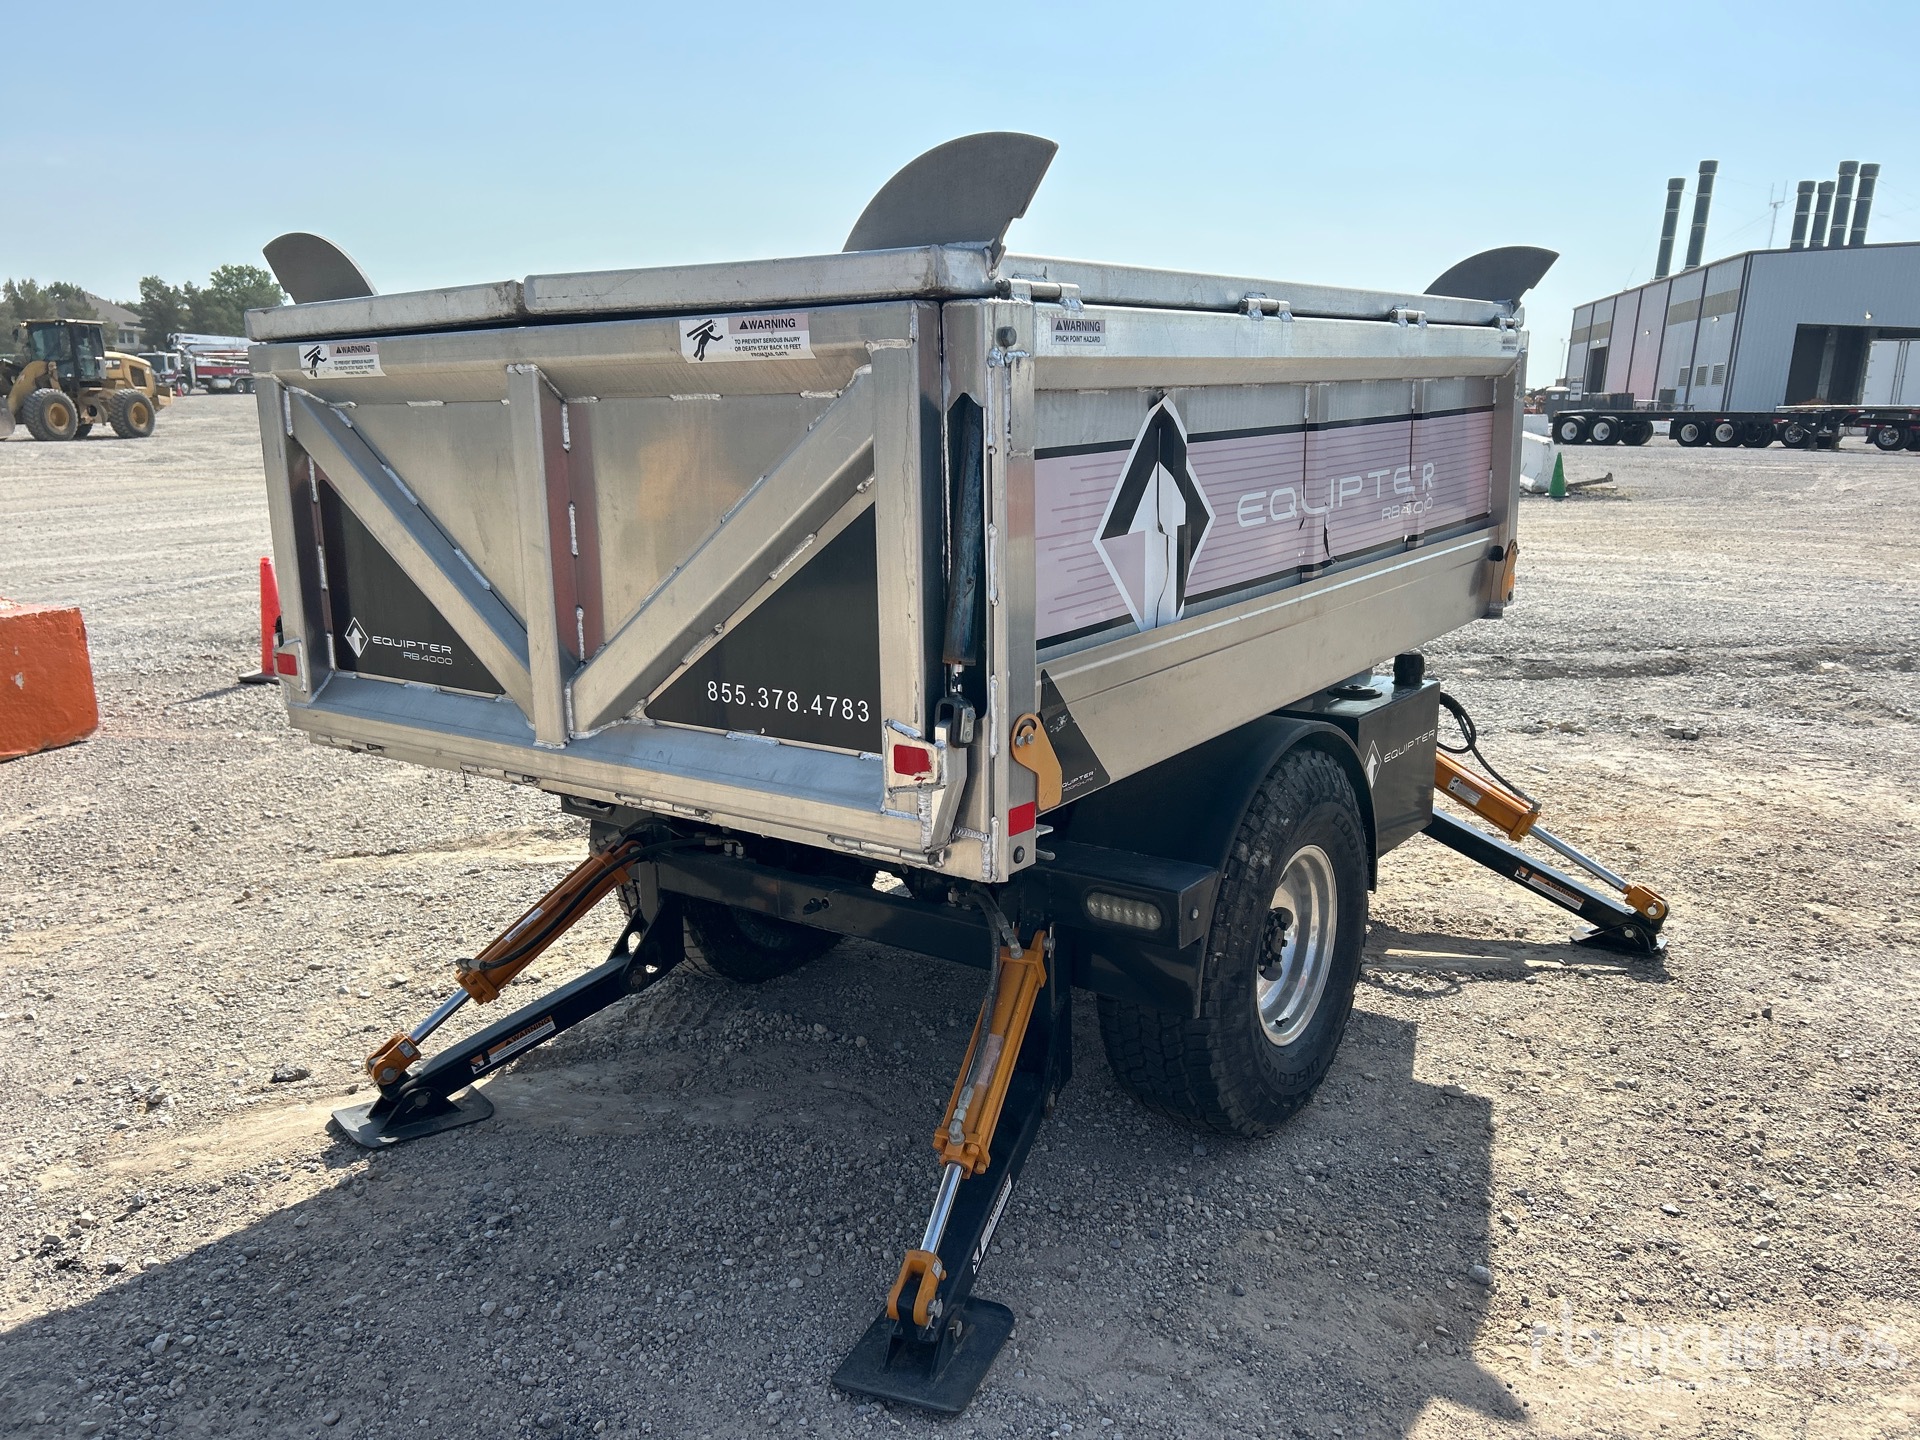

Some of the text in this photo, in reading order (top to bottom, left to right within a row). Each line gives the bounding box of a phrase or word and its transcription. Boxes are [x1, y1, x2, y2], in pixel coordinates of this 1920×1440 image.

[748, 318, 796, 330] WARNING
[1062, 319, 1101, 332] WARNING
[762, 336, 783, 344] SERIOUS
[1070, 335, 1083, 343] POINT
[1083, 335, 1101, 343] HAZARD
[341, 344, 371, 354] WARNING
[1236, 462, 1435, 528] EQUIPTER
[372, 635, 453, 655] EQUIPTER
[707, 680, 870, 723] 855.378.4783
[1383, 729, 1436, 763] EQUIPTER
[1062, 771, 1095, 788] QUIPTER
